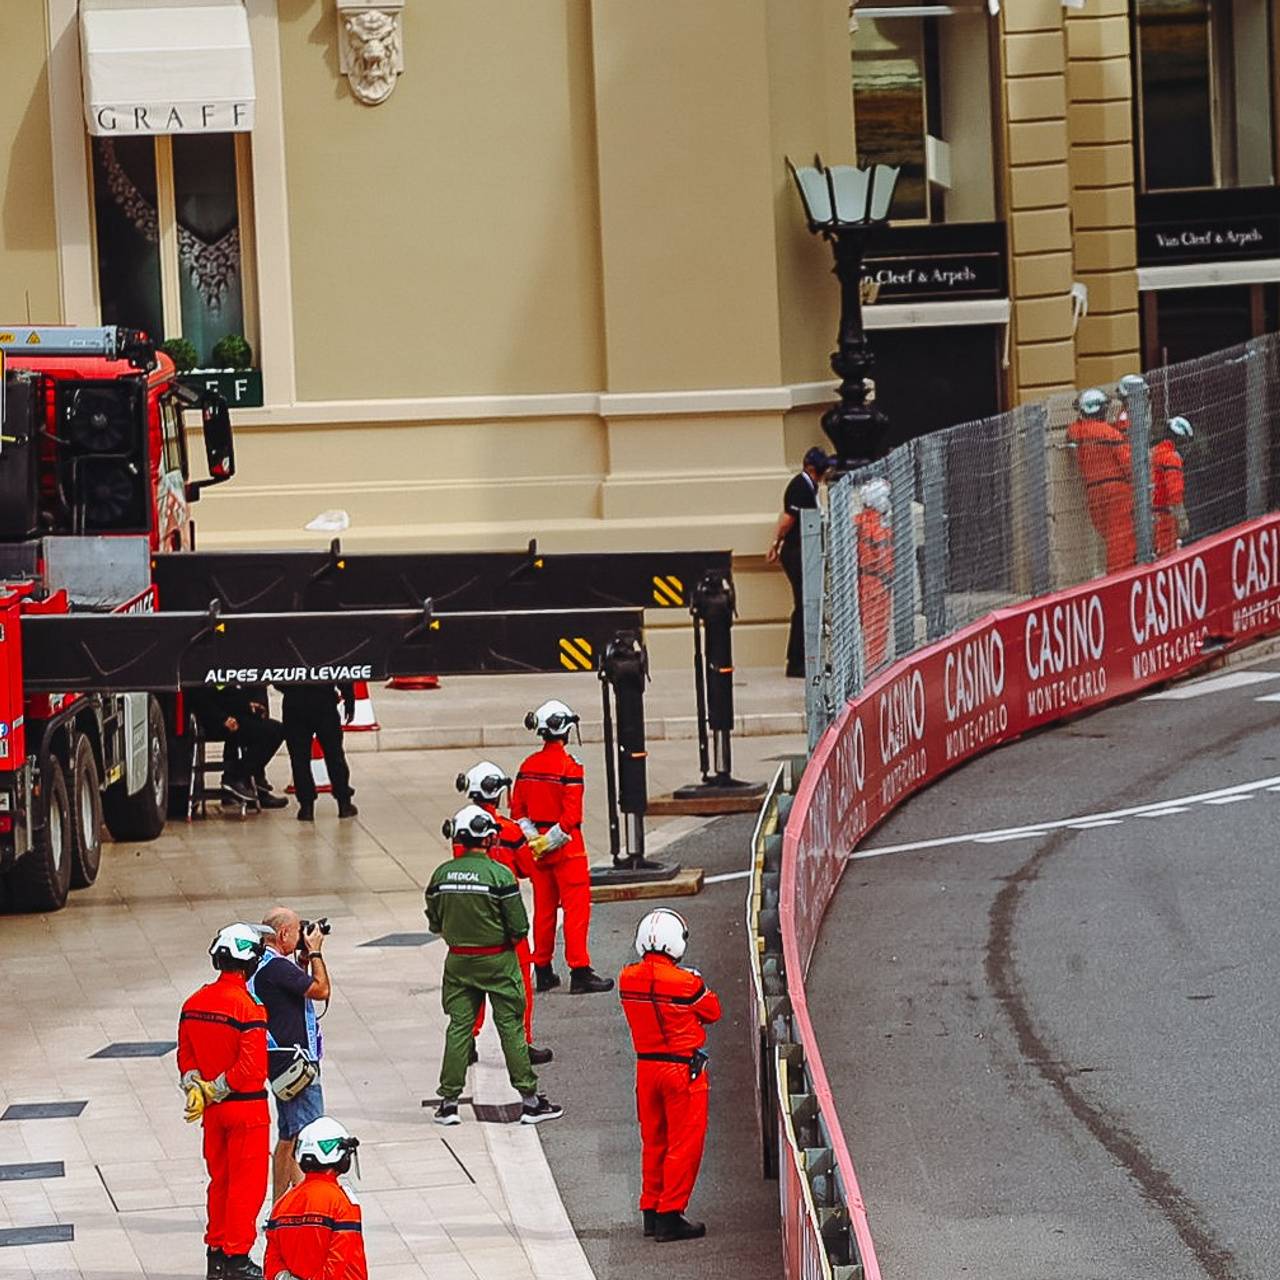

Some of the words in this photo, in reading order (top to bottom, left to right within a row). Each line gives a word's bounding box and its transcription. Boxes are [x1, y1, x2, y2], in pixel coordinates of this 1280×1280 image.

[97, 103, 250, 131] GRAFF
[876, 269, 915, 286] Cleef
[918, 272, 928, 282] &
[932, 266, 976, 285] Arpels
[1130, 556, 1208, 645] CASINO
[1025, 595, 1104, 680] CASINO
[205, 669, 258, 683] ALPES
[261, 667, 307, 681] AZUR
[310, 665, 372, 680] LEVAGE
[944, 628, 1004, 722] CASINO
[880, 669, 925, 766] CASINO
[447, 872, 479, 882] MEDICAL
